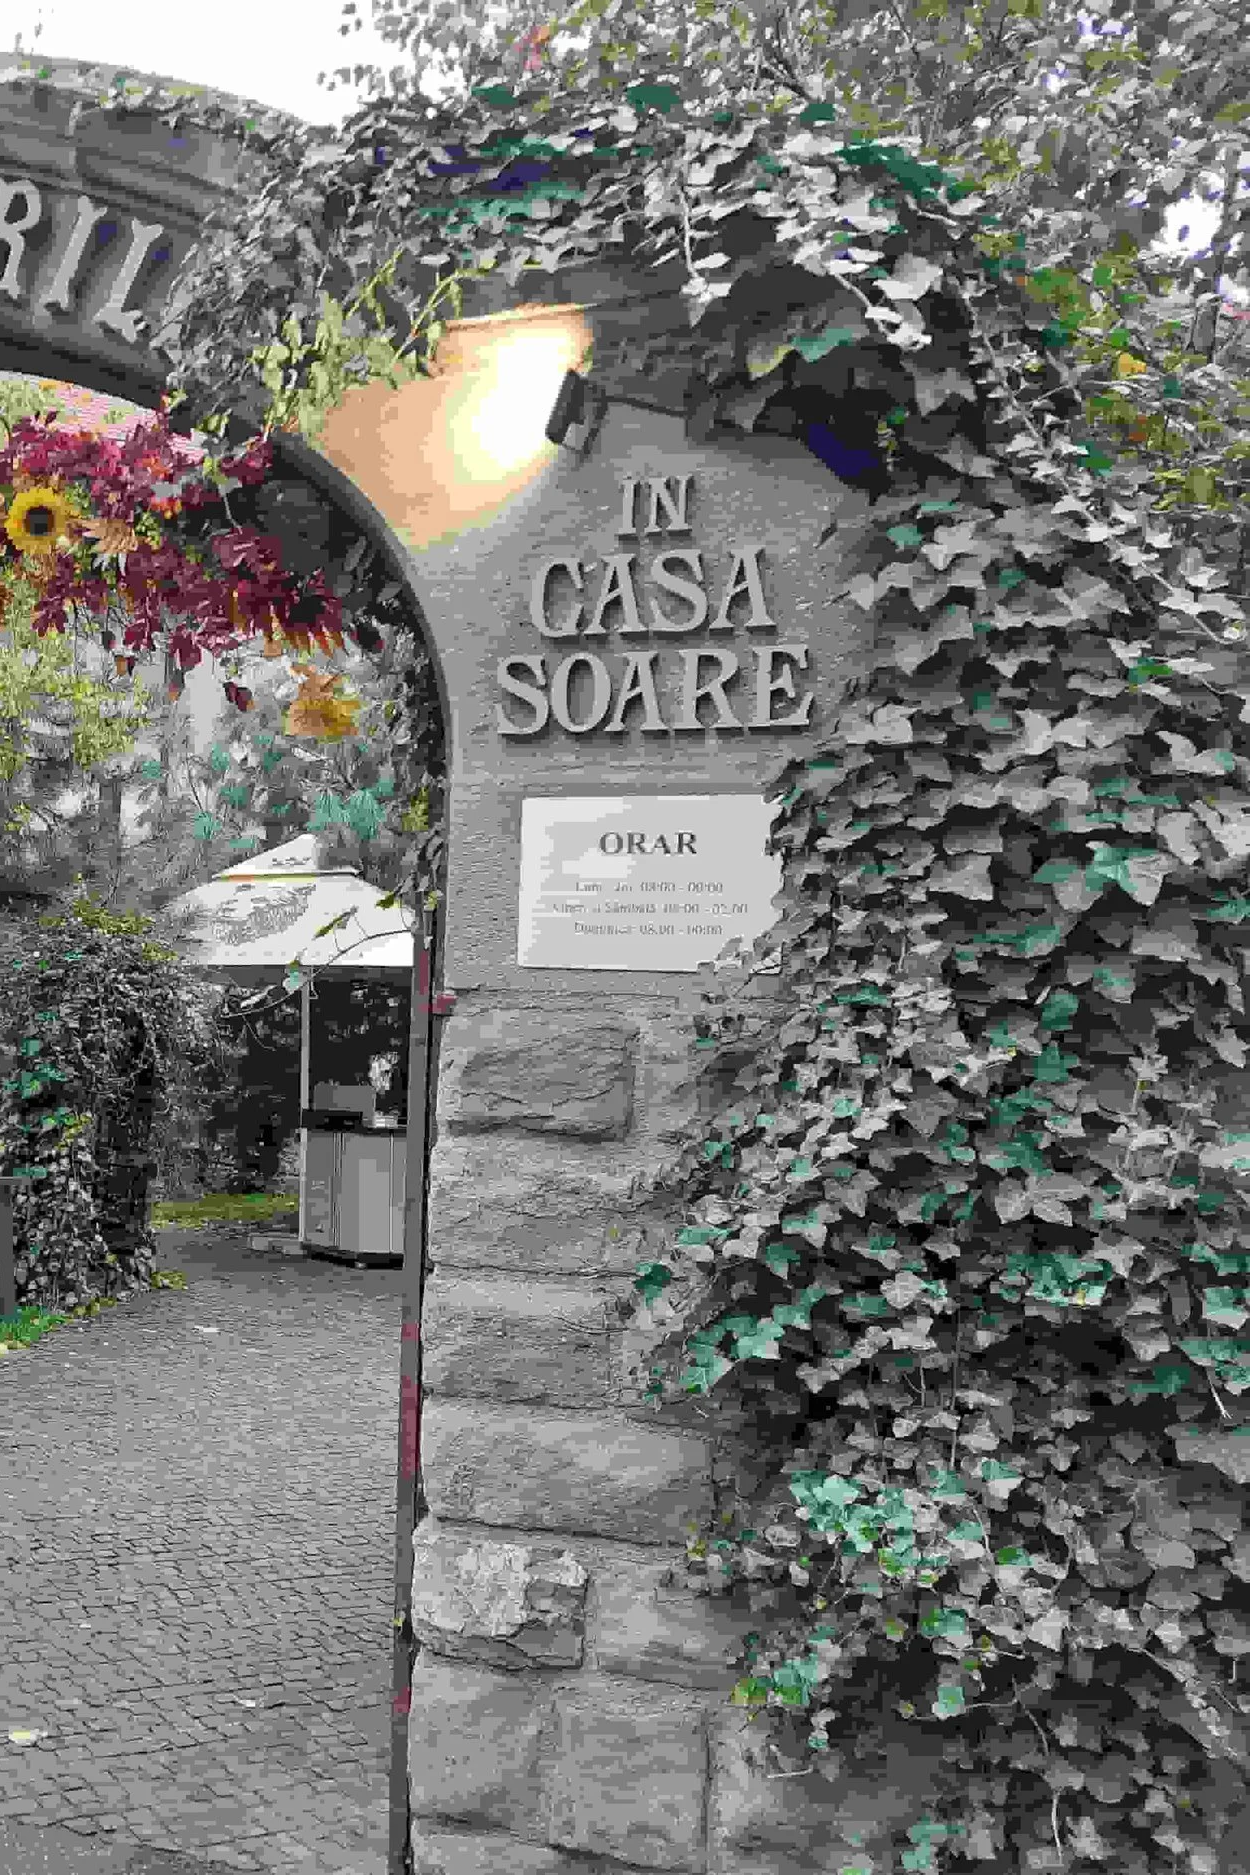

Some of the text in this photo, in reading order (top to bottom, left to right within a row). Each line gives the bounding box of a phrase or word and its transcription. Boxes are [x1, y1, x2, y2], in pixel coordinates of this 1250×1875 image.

[618, 474, 693, 535] IN
[529, 547, 777, 639] CASA
[496, 643, 815, 736] SOARE
[599, 831, 698, 855] ORAR
